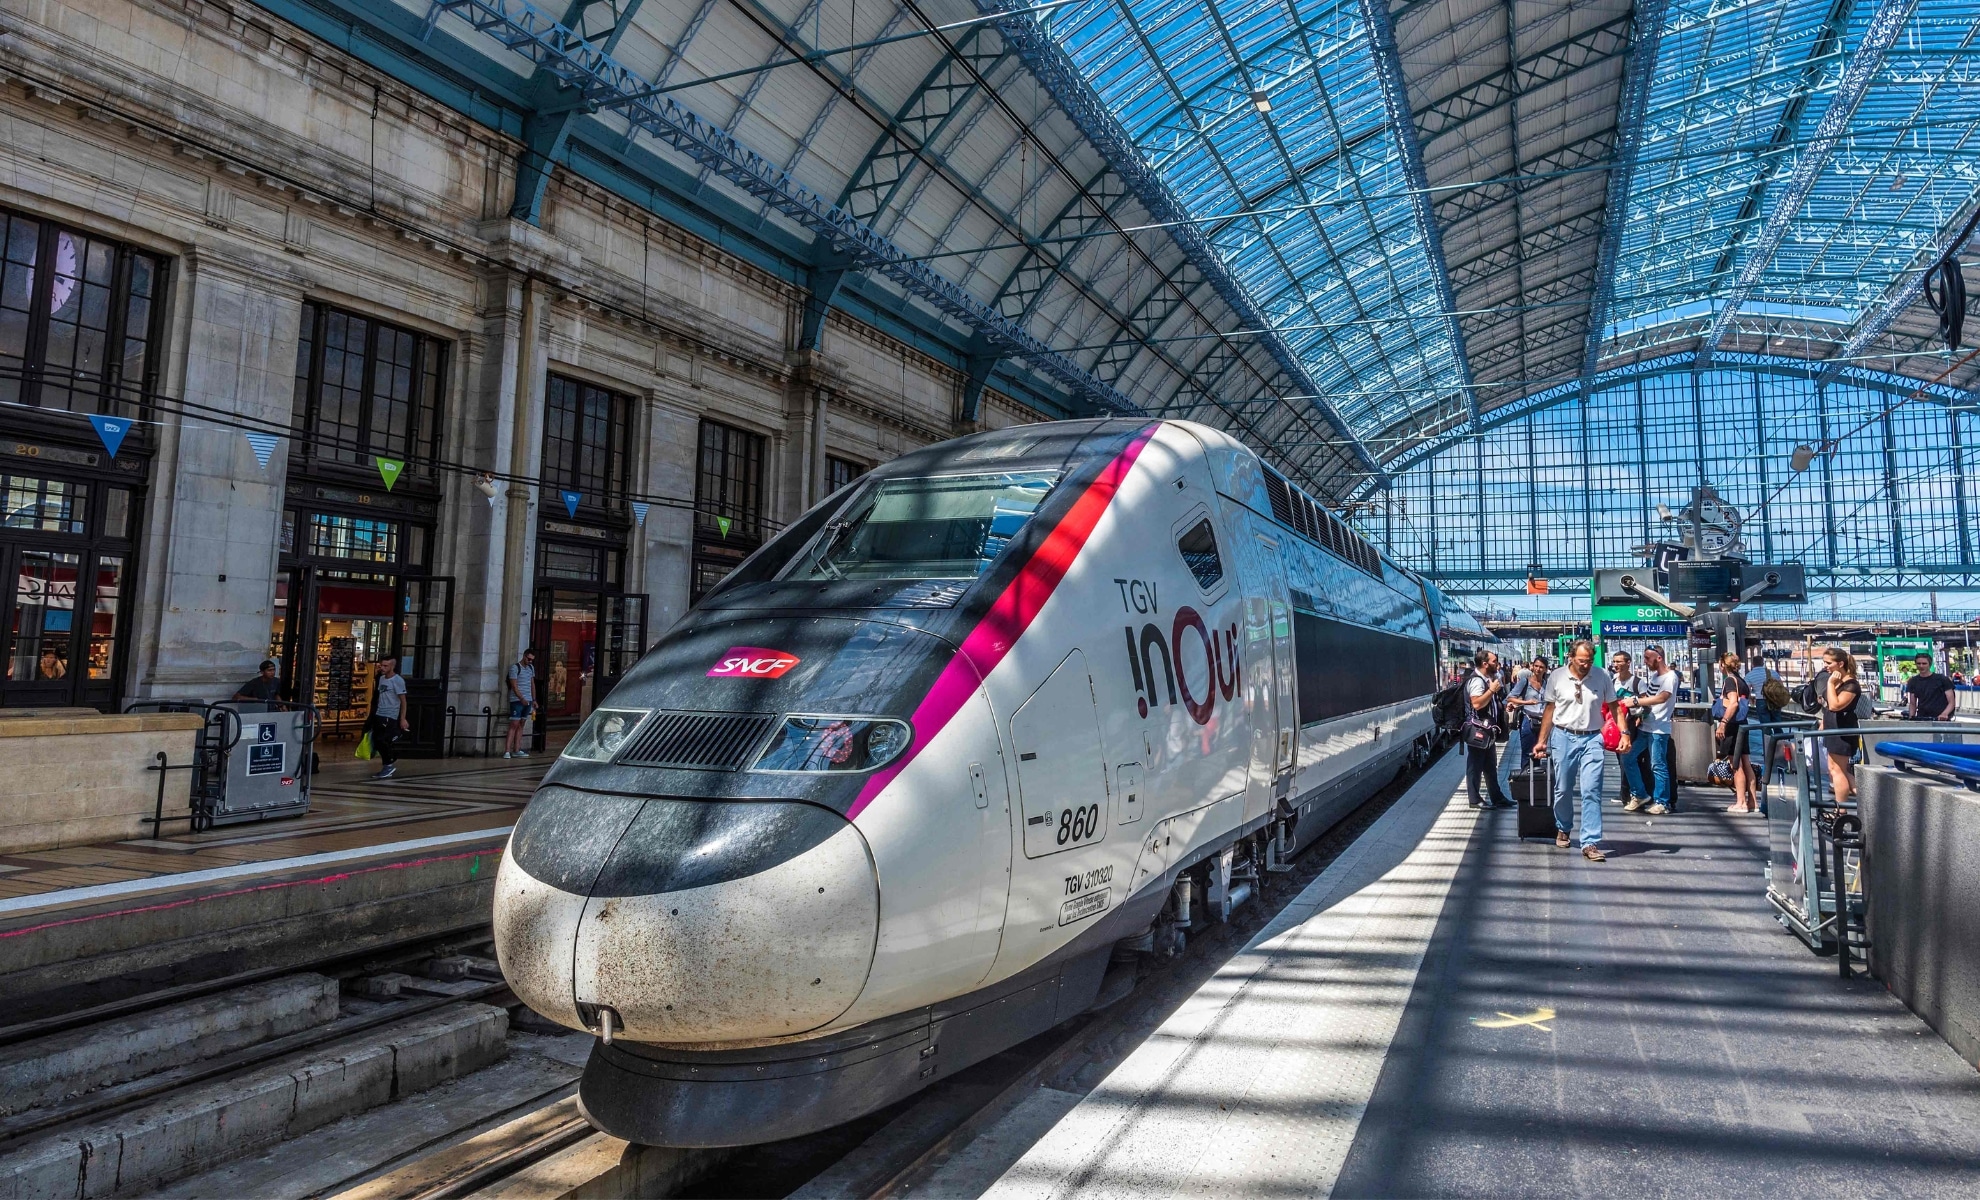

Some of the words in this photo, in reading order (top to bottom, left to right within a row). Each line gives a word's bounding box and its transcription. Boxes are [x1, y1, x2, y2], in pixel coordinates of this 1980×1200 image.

[16, 444, 40, 457] 20
[358, 495, 371, 504] 19
[1114, 578, 1157, 614] TGV
[713, 658, 794, 674] SNCF
[1057, 803, 1098, 845] 860
[1065, 873, 1084, 896] TGV
[1084, 864, 1113, 890] 310320
